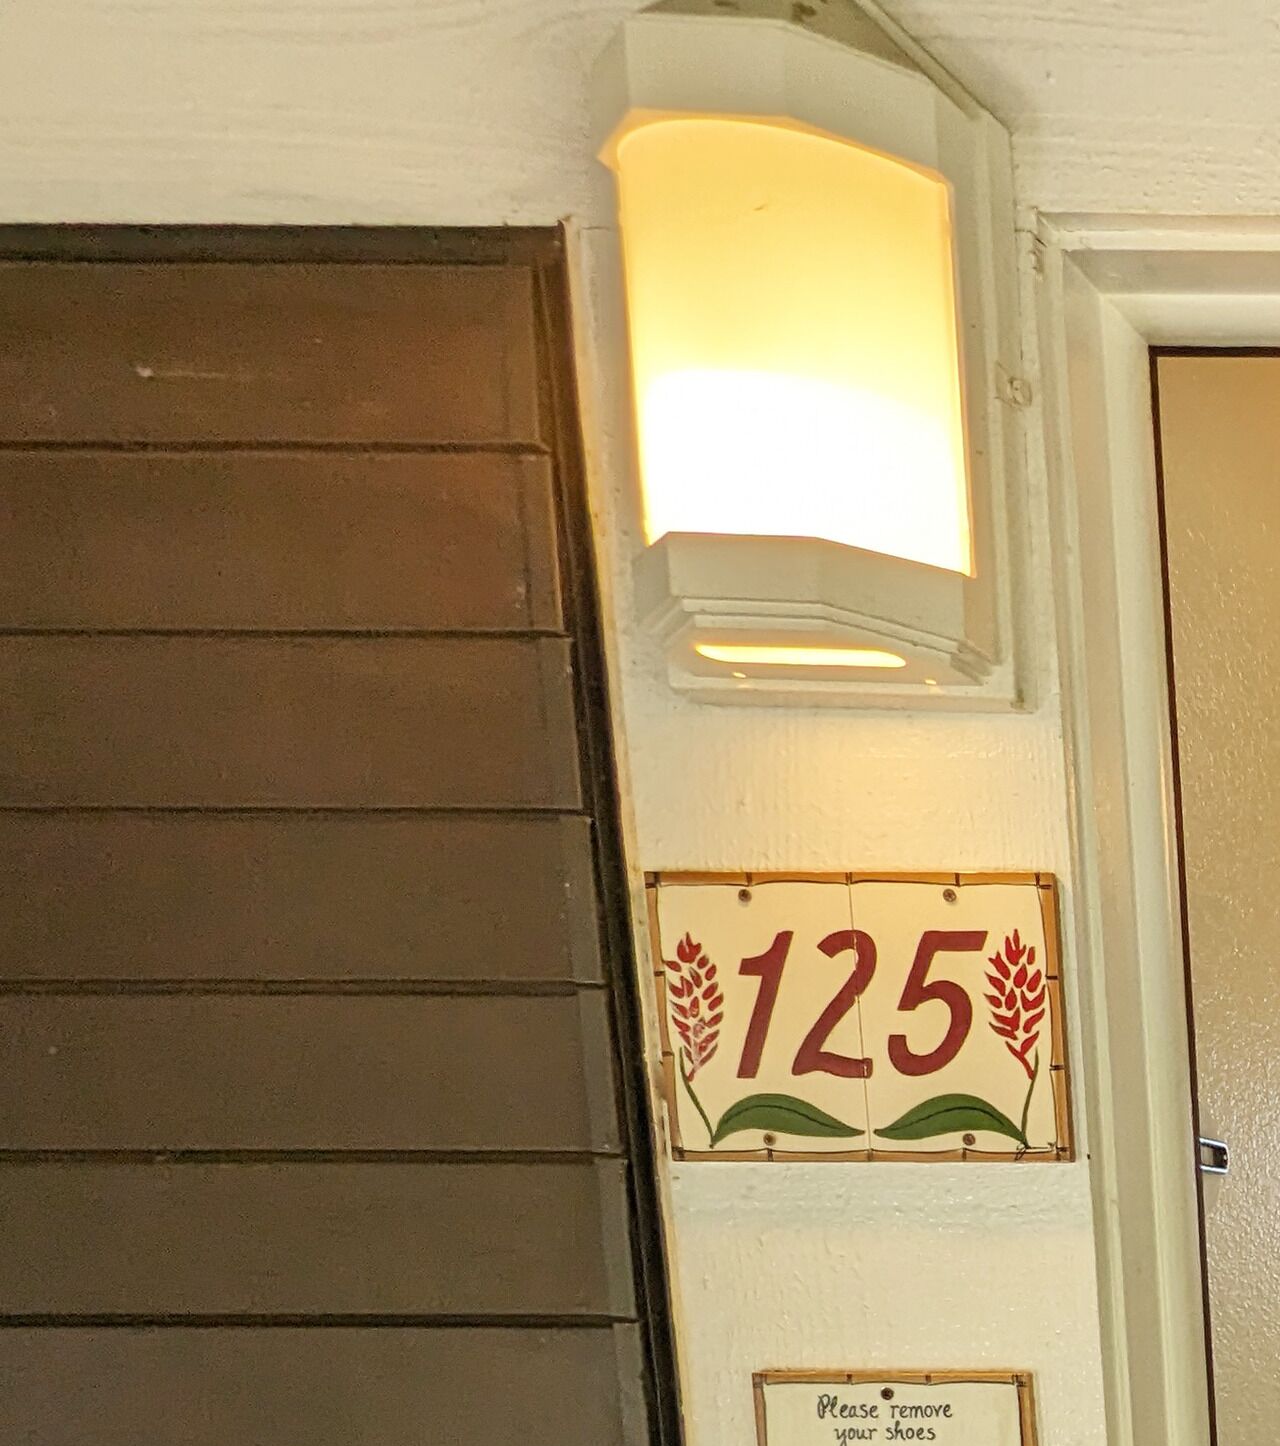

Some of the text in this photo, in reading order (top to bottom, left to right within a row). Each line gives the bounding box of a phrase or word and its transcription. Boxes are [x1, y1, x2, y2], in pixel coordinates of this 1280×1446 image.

[737, 929, 988, 1078] 125
[817, 1394, 953, 1419] Please remove
[885, 1421, 936, 1440] shoes
